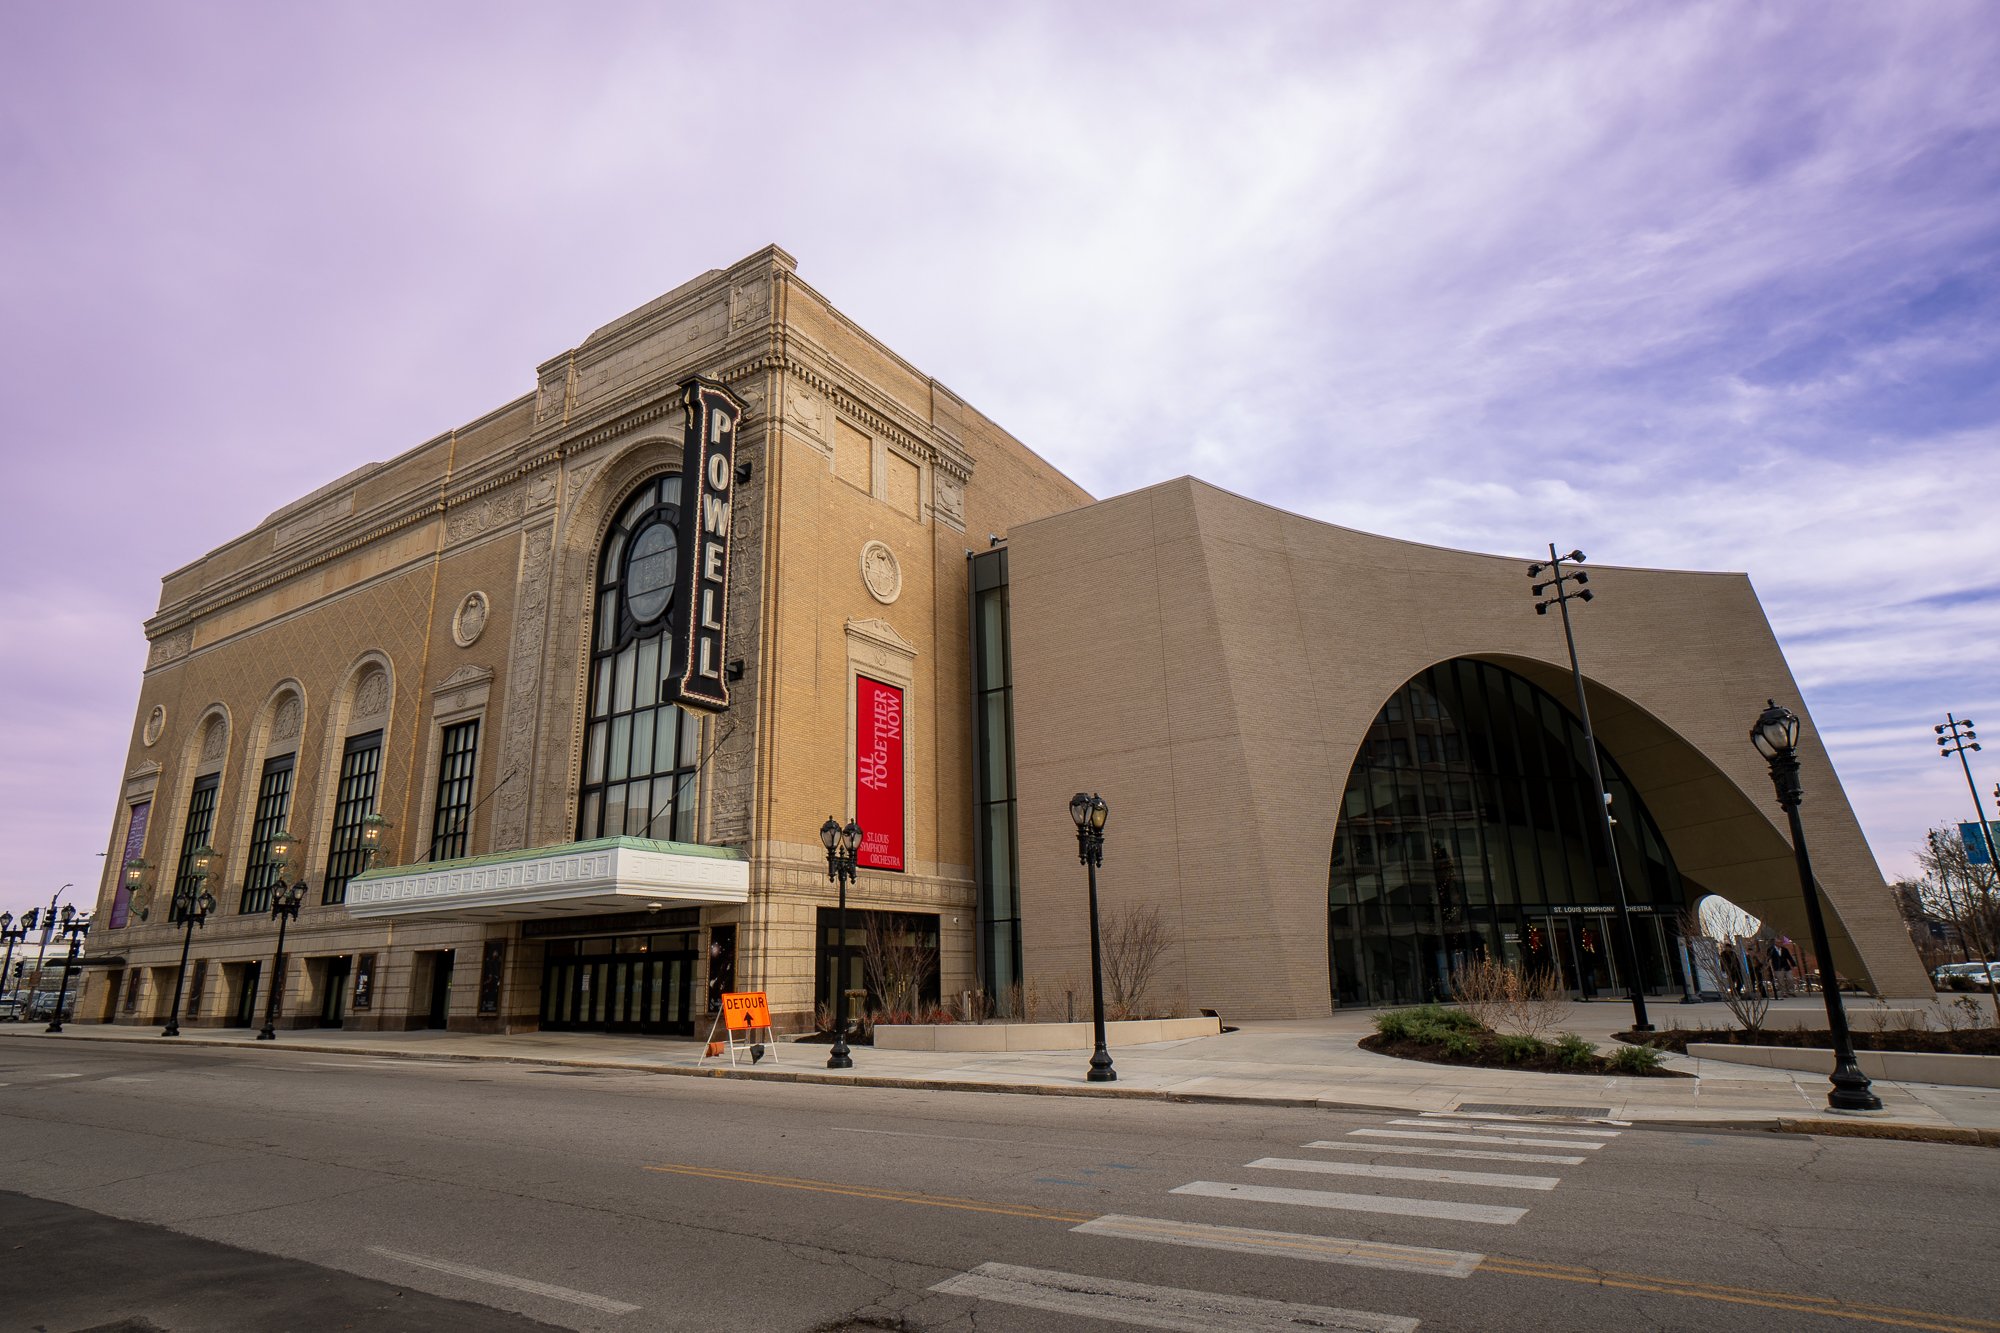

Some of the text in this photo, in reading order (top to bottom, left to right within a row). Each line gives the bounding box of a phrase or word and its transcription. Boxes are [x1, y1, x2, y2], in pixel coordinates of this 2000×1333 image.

[700, 407, 732, 680] POWELL
[887, 692, 900, 740] NOW
[874, 690, 888, 790] TOGETHER
[860, 753, 874, 789] ALL
[860, 841, 889, 854] SYMPHONY
[867, 831, 889, 844] ST. LOUIS
[870, 854, 901, 866] ORCHESTRA
[726, 997, 765, 1010] DETOUR
